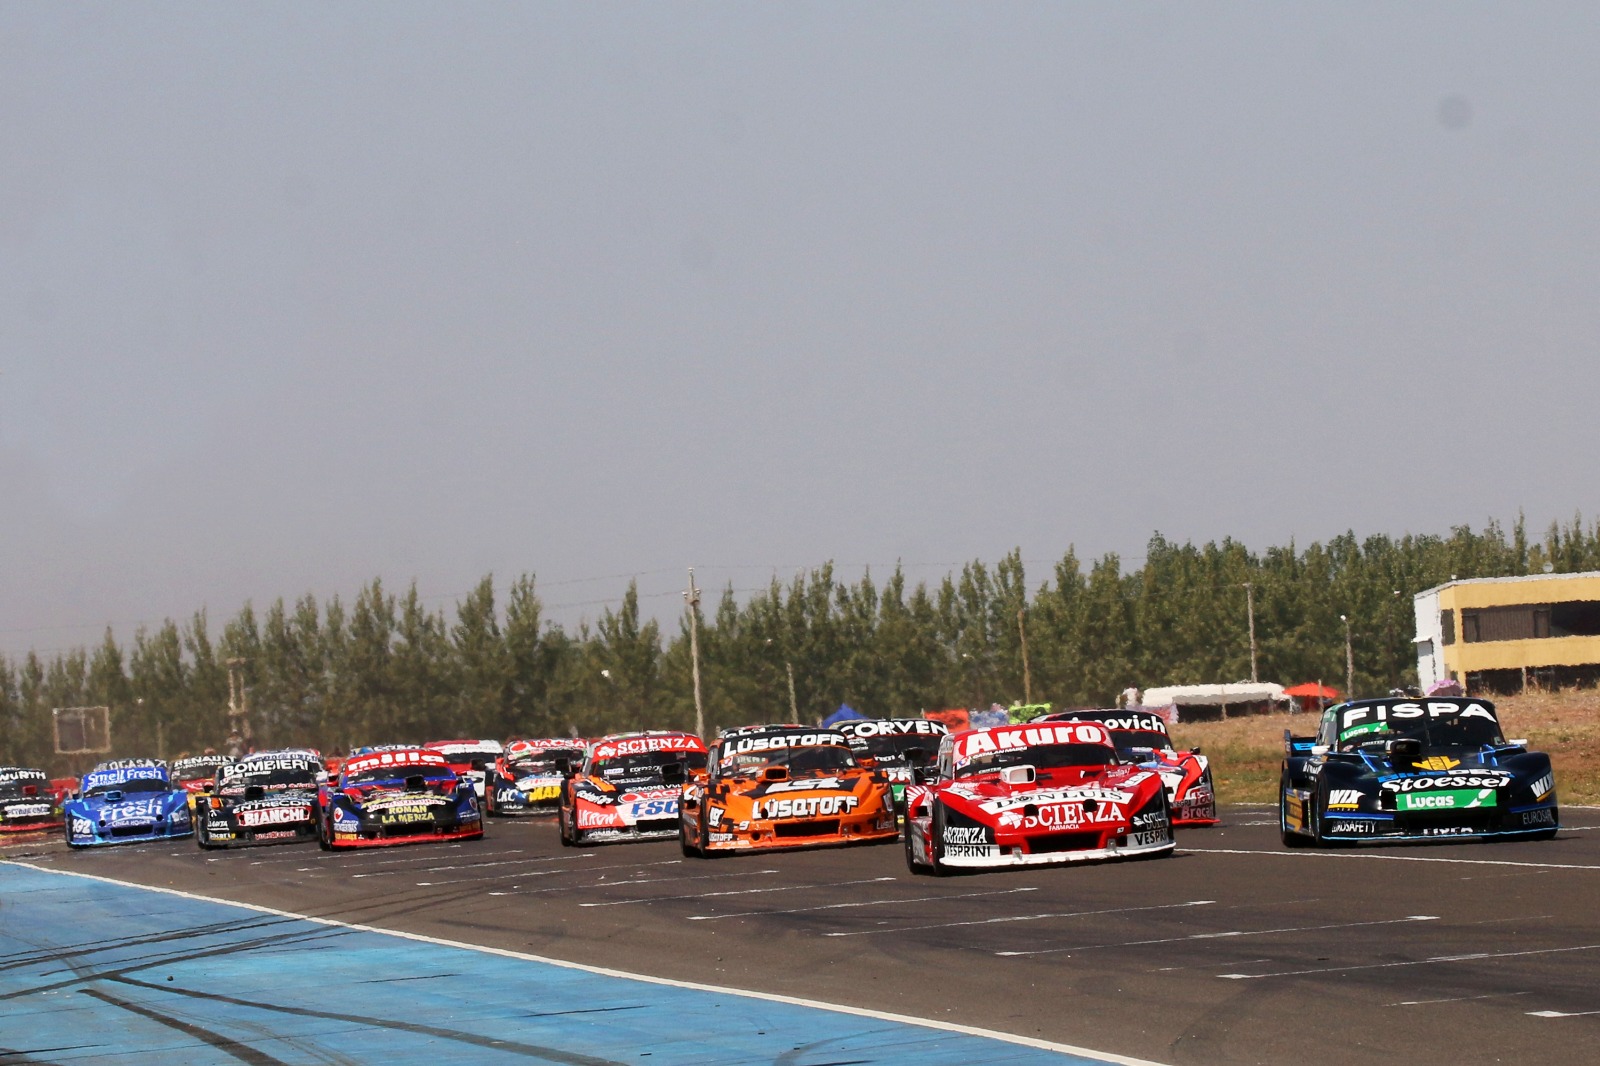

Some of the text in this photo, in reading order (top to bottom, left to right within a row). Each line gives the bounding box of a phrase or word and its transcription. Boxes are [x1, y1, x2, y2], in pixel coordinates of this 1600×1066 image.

[1343, 703, 1497, 729] FISPA
[841, 721, 950, 739] CORVEN
[1344, 728, 1369, 739] Lucas
[532, 739, 586, 749] TACSA
[617, 738, 700, 751] SCIENZA
[966, 725, 1103, 756] Akuro
[174, 755, 237, 767] RENAULT
[223, 760, 309, 777] BOMBIERI
[88, 768, 162, 781] Smell Fresh
[1381, 776, 1511, 793] Stoessel
[1328, 789, 1362, 804] WIX
[1405, 793, 1455, 809] Lucas
[243, 808, 306, 827] BIANCHI
[1024, 802, 1127, 829] SCIENZA
[948, 826, 988, 844] SCIENZA
